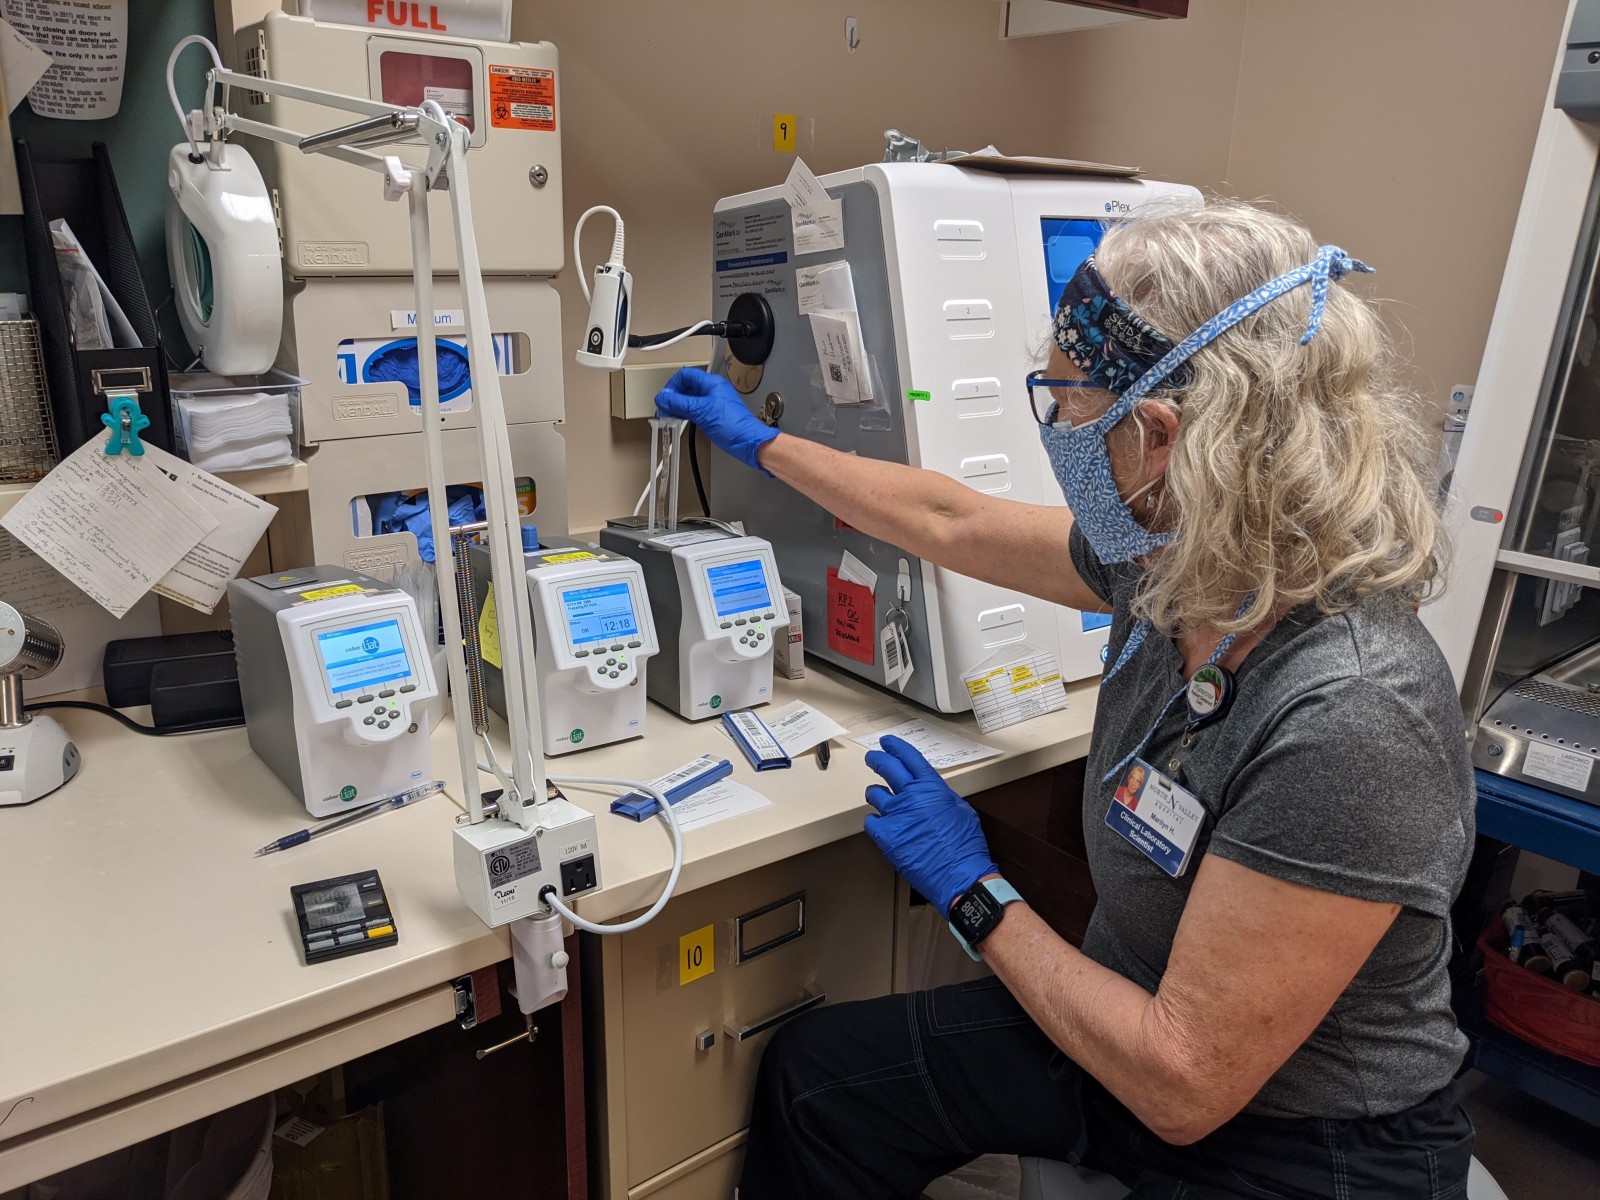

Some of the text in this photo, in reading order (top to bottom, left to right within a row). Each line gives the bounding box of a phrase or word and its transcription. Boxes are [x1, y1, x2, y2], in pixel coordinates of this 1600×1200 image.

[367, 0, 446, 31] FULL
[780, 123, 787, 140] 9
[604, 618, 631, 632] 12:18
[362, 640, 379, 651] Liat
[340, 786, 357, 800] Liat
[1149, 784, 1169, 801] NORTH
[1178, 804, 1200, 822] VALLEY
[1120, 811, 1172, 856] Clinical Laboratory
[1150, 812, 1169, 831] Marilyn
[1129, 829, 1154, 853] Scientist
[961, 901, 985, 927] 12:08
[687, 945, 703, 970] 10
